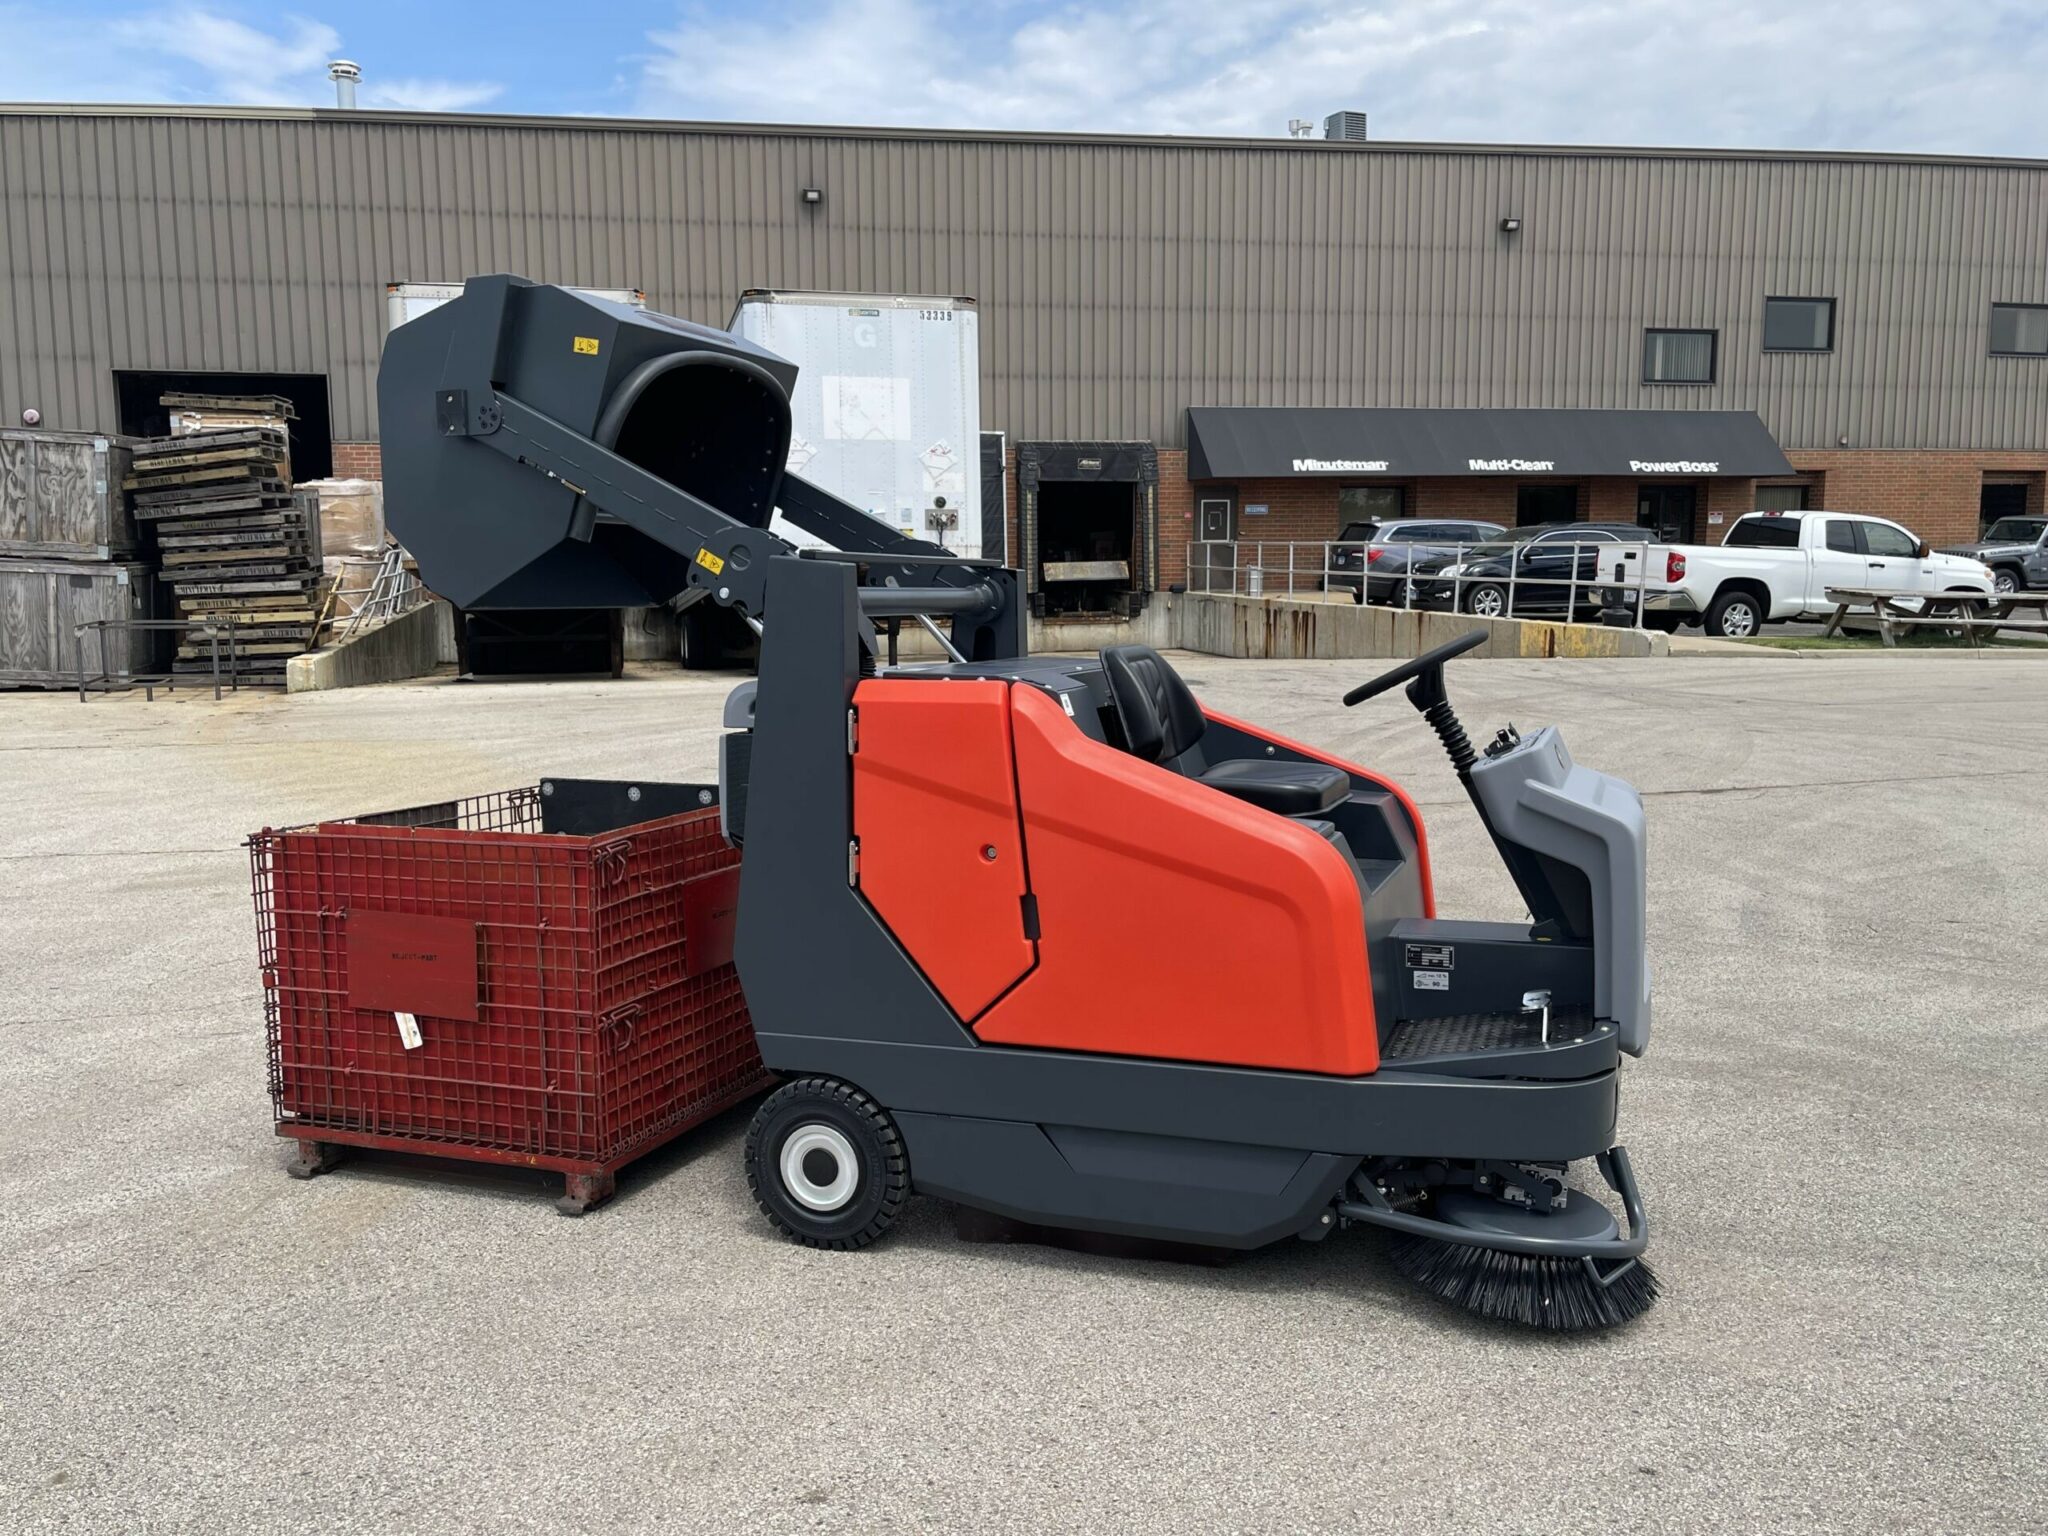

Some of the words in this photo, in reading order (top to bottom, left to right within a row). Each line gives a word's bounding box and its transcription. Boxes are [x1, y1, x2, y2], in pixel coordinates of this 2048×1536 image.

[919, 311, 952, 321] 53339
[1292, 459, 1387, 471] Minuteman
[1468, 459, 1553, 471] Multi-Clean
[1629, 461, 1718, 472] PowerBoss
[180, 584, 216, 595] MINUTEMAN
[197, 599, 233, 609] MINUTEMAN
[206, 613, 241, 623] MINUTEMAN
[248, 613, 255, 622] 4
[263, 629, 297, 638] MINUTEMAN
